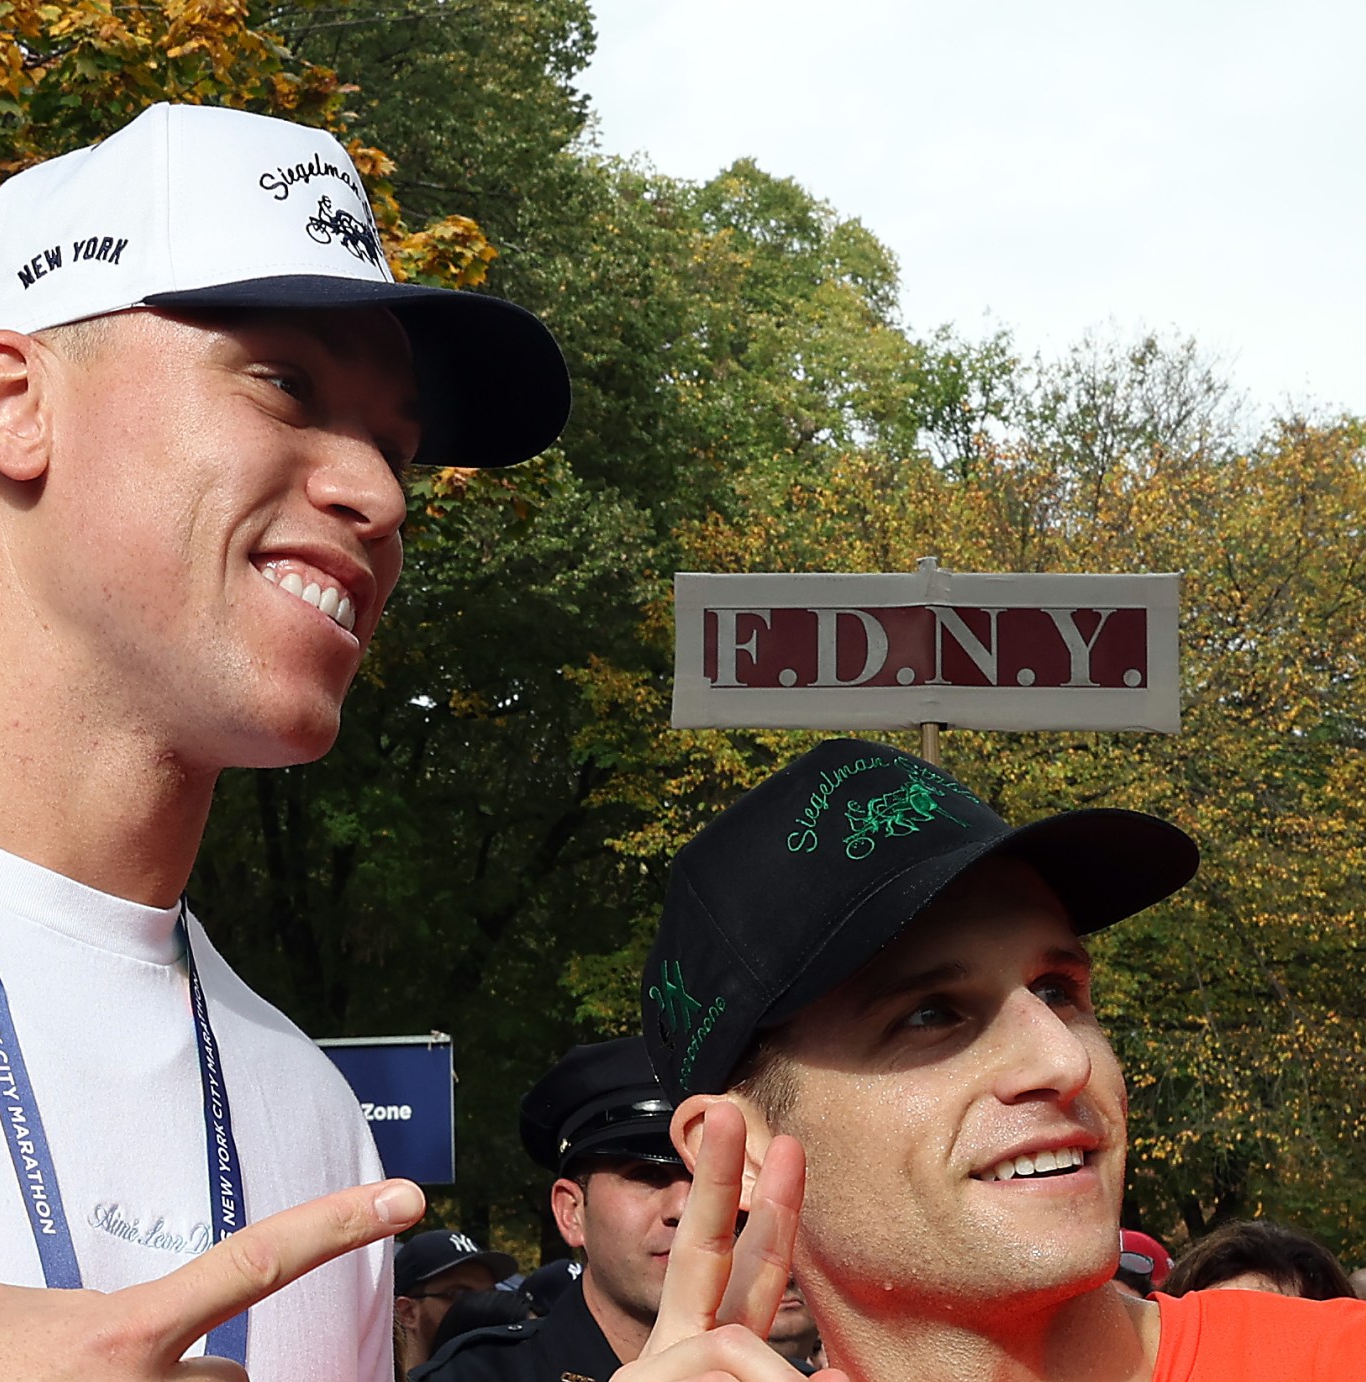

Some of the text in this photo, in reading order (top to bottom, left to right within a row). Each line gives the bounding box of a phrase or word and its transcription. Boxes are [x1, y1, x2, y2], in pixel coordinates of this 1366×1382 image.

[17, 236, 129, 290] NEW YORK
[707, 607, 1143, 687] F.D.N.Y.
[787, 756, 890, 853] Siegelman
[192, 971, 217, 1074] MARATHON
[208, 1072, 223, 1120] CITY
[361, 1102, 413, 1121] Zone
[7, 1106, 57, 1235] MARATHON
[213, 1119, 231, 1172] YORK
[219, 1175, 237, 1227] NEW
